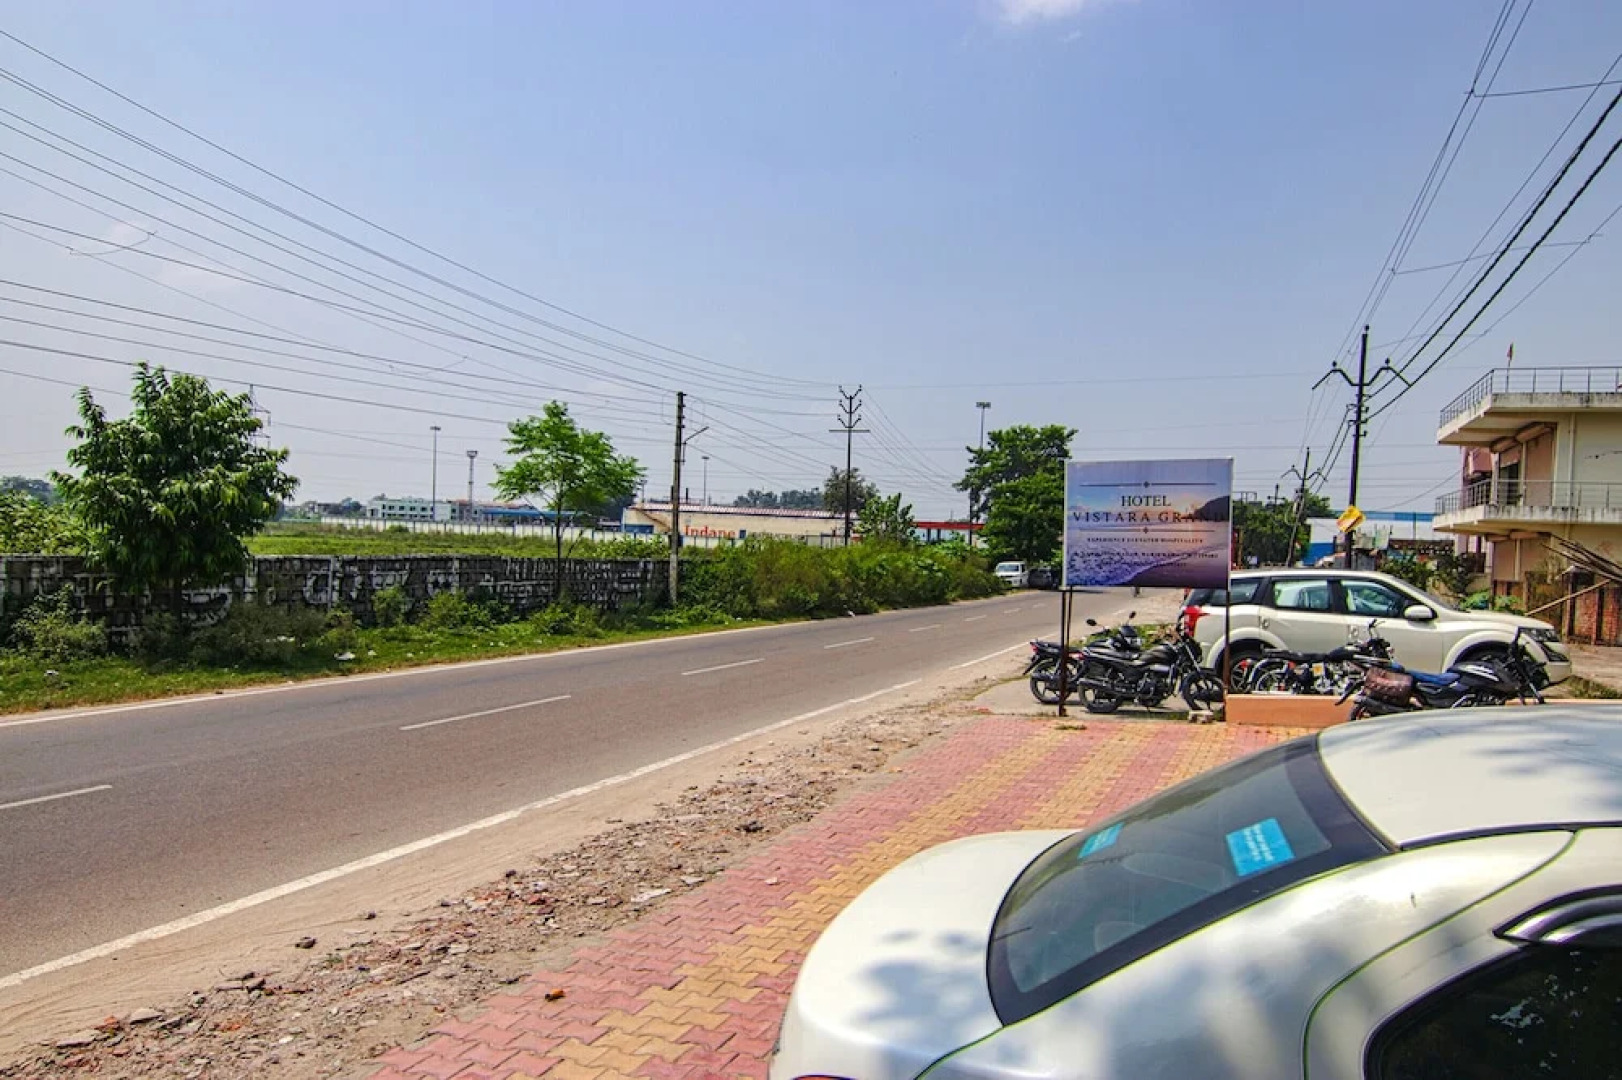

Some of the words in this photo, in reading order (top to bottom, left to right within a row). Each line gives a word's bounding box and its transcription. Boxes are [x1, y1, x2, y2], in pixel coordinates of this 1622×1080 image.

[1121, 495, 1172, 507] HOTEL
[1073, 511, 1151, 523] VISTARA
[685, 525, 736, 539] Indane
